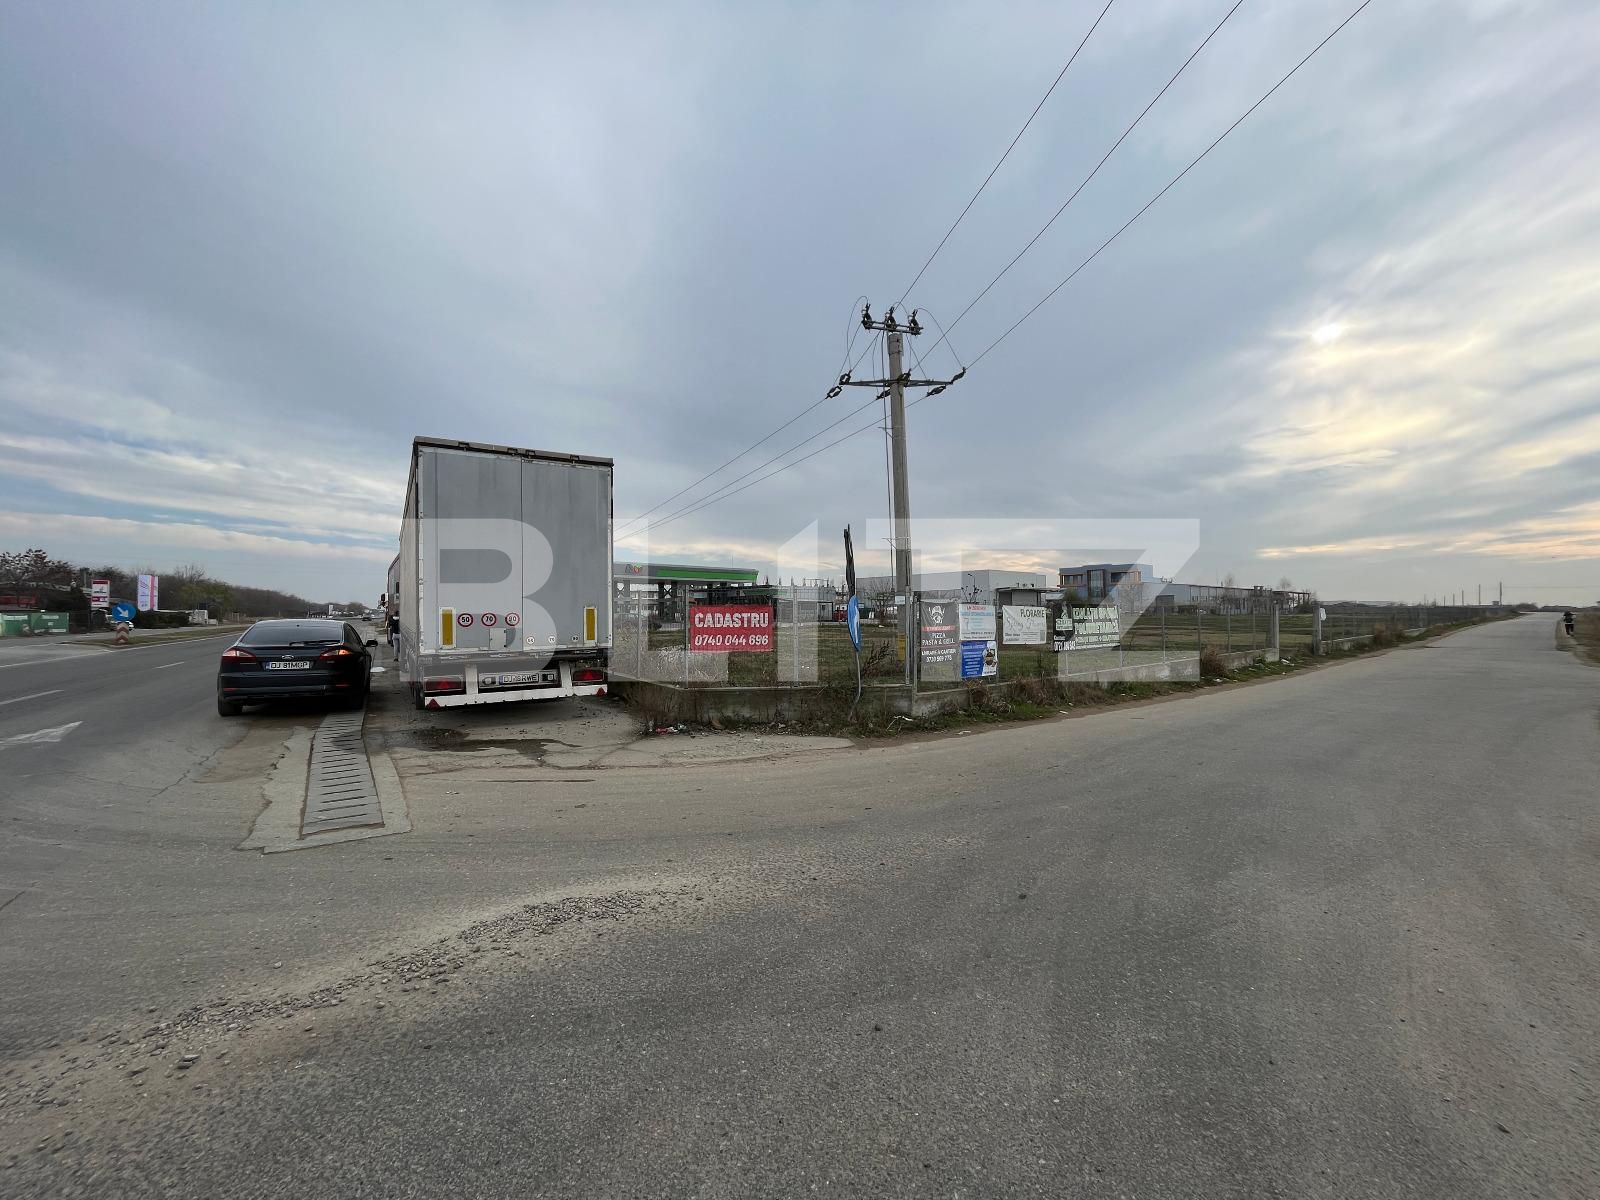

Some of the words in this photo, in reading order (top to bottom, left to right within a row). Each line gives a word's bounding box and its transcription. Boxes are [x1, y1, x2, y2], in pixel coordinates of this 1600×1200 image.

[694, 612, 769, 628] CADASTRU
[694, 634, 722, 646] 0740
[724, 634, 746, 646] 044
[748, 634, 769, 646] 696
